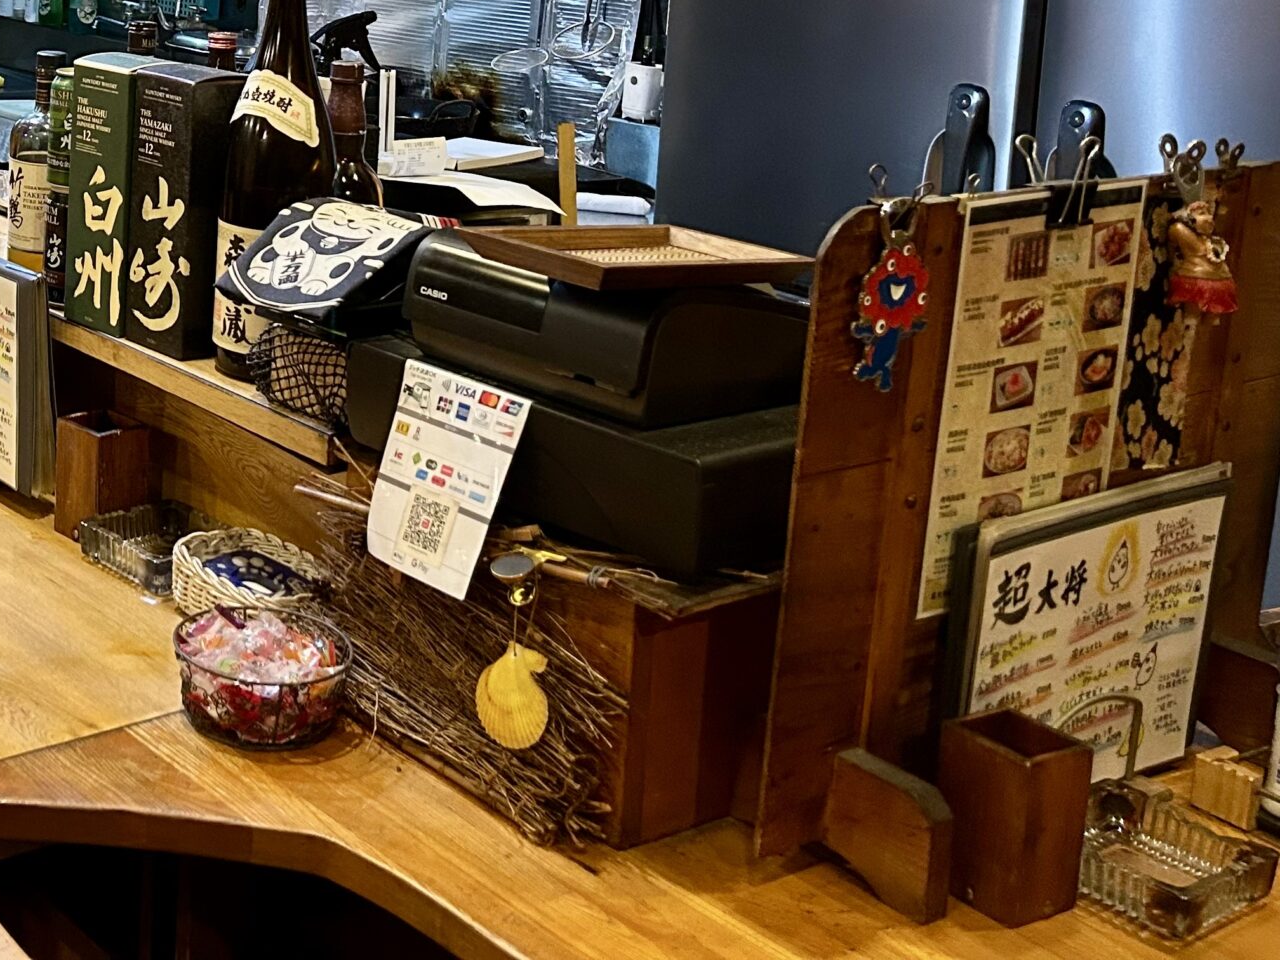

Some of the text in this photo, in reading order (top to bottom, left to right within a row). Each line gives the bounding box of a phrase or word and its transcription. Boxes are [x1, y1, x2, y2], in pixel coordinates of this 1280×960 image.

[77, 96, 89, 105] THE
[77, 105, 108, 119] HAKUSHU
[140, 109, 152, 118] THE
[140, 117, 172, 133] YAMAZAKI
[82, 129, 91, 142] 12
[145, 142, 154, 155] 12
[74, 165, 123, 327] 白州
[129, 176, 191, 332] 山崎
[420, 285, 448, 301] CASIO
[455, 383, 477, 399] VISA
[990, 558, 1088, 631] 超大将
